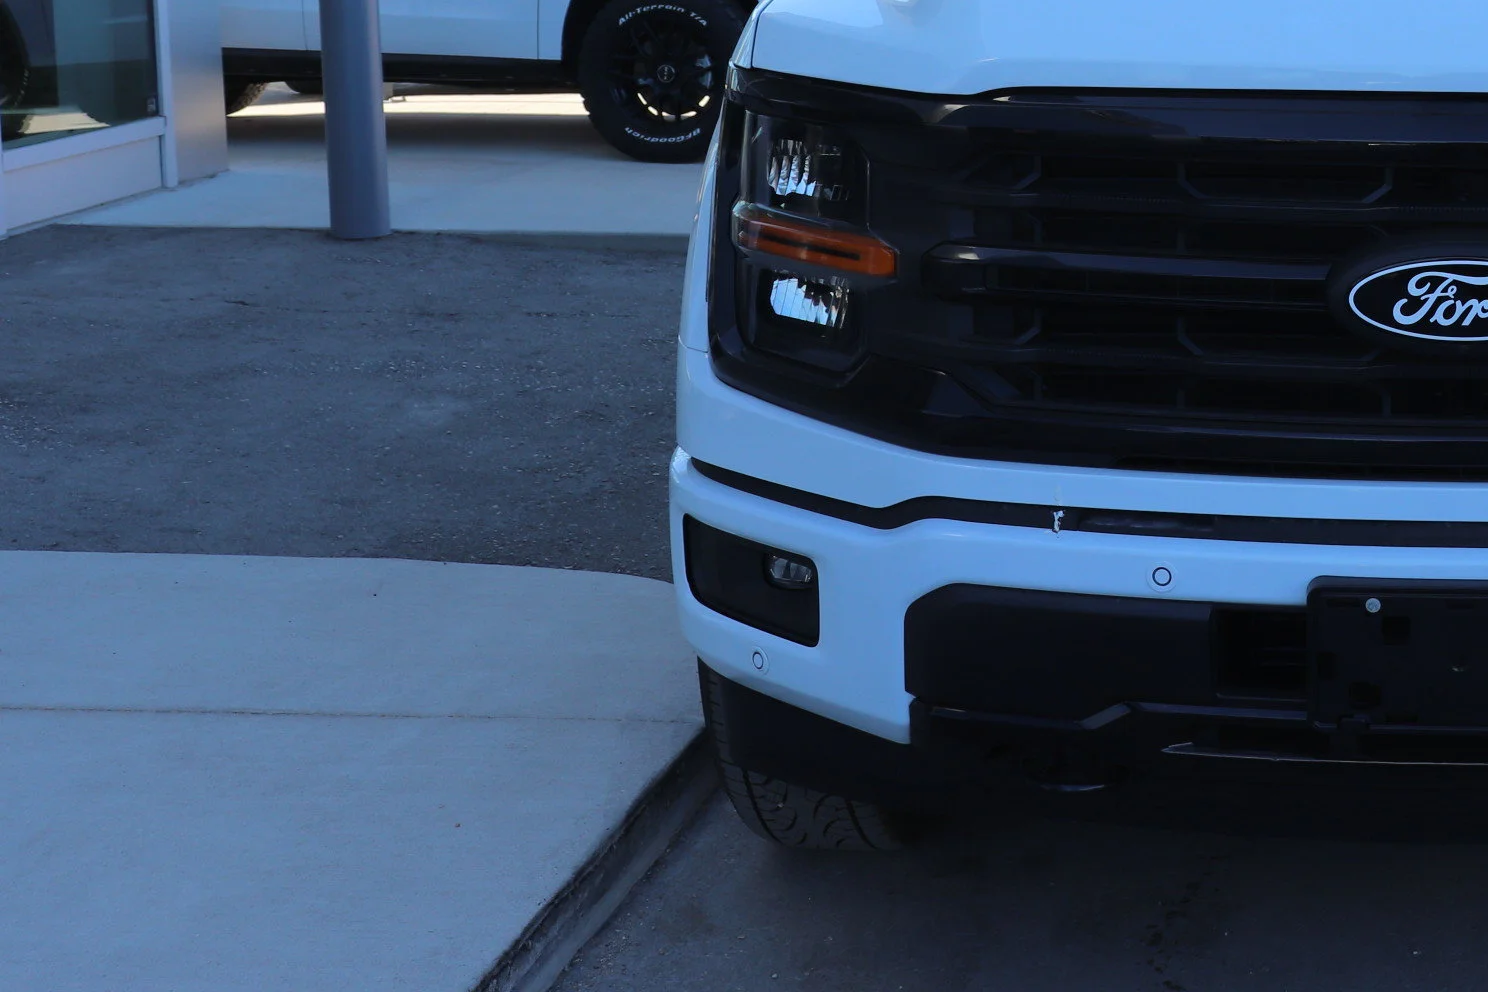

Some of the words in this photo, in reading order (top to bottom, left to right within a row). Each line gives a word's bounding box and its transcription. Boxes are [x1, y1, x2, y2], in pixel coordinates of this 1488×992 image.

[618, 4, 685, 26] All-Terrain
[690, 12, 707, 26] T/A
[624, 127, 701, 143] BFGoodrich
